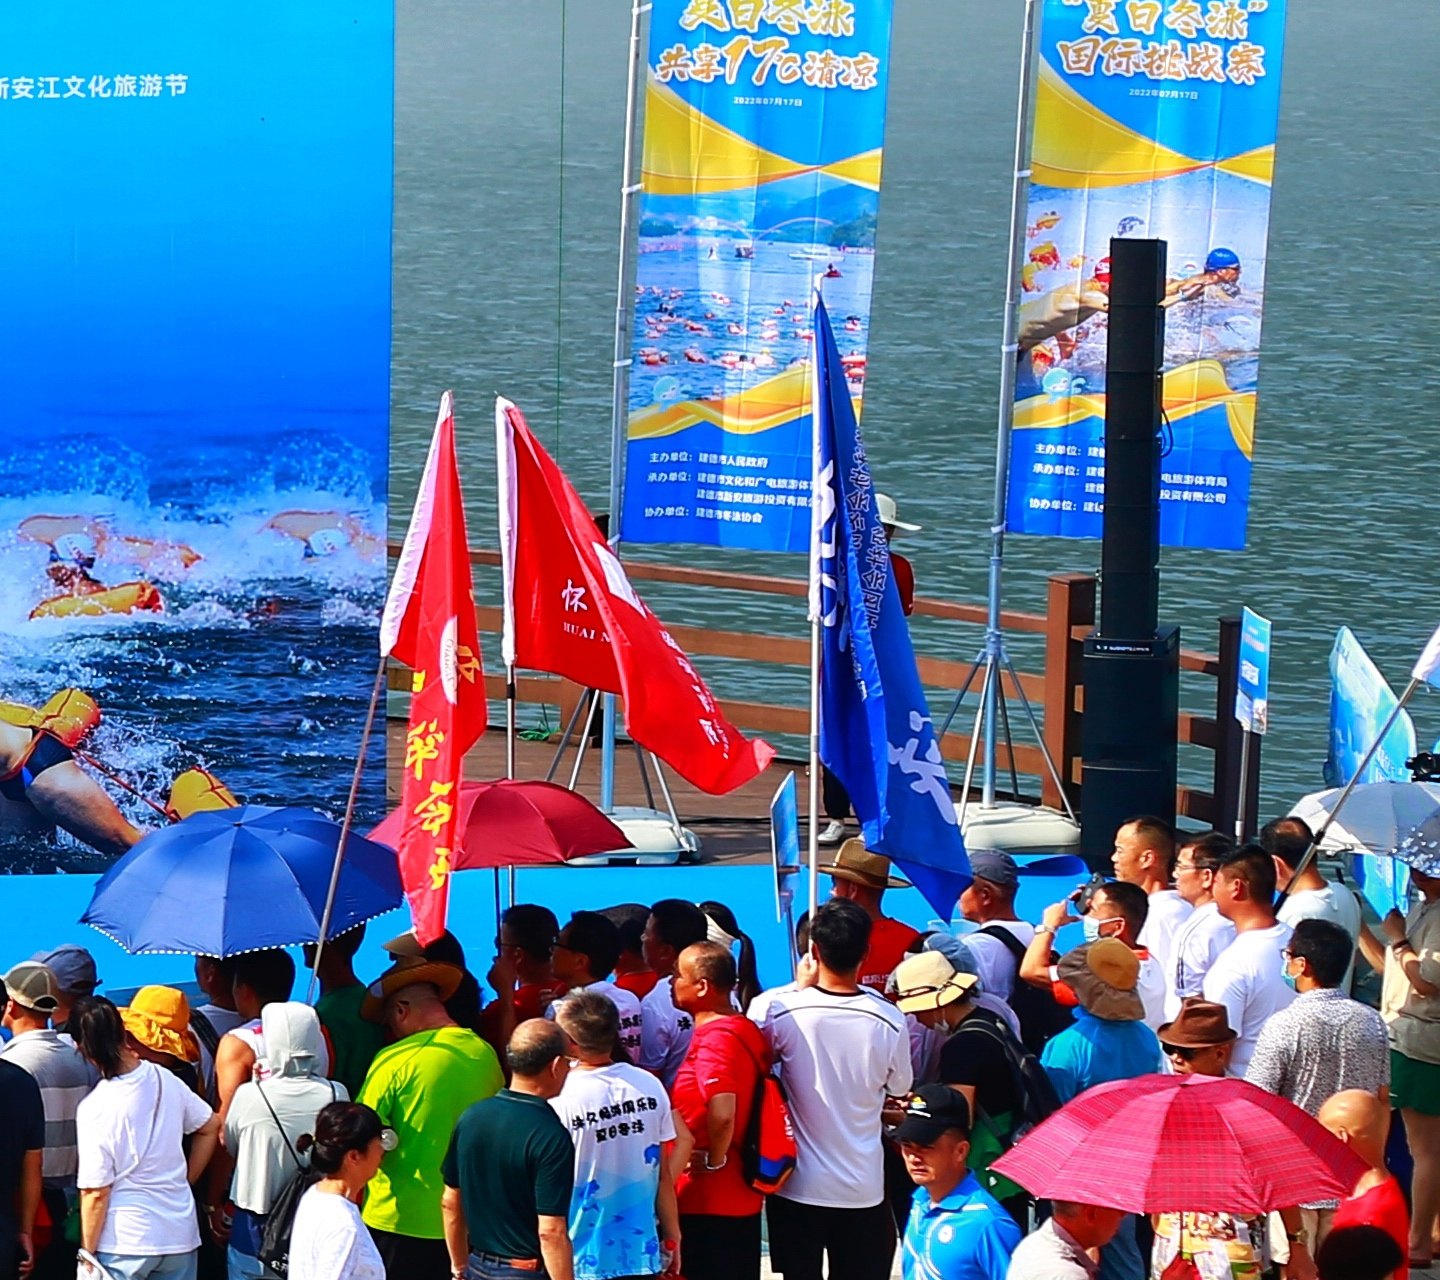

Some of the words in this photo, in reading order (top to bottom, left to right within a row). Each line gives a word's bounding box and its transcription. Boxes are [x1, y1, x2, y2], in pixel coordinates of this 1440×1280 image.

[1058, 38, 1267, 87] 国际挑战赛
[697, 472, 813, 491] 建德市文化和广电旅游体
[696, 488, 813, 507] 建德市新安旅游投资有限公
